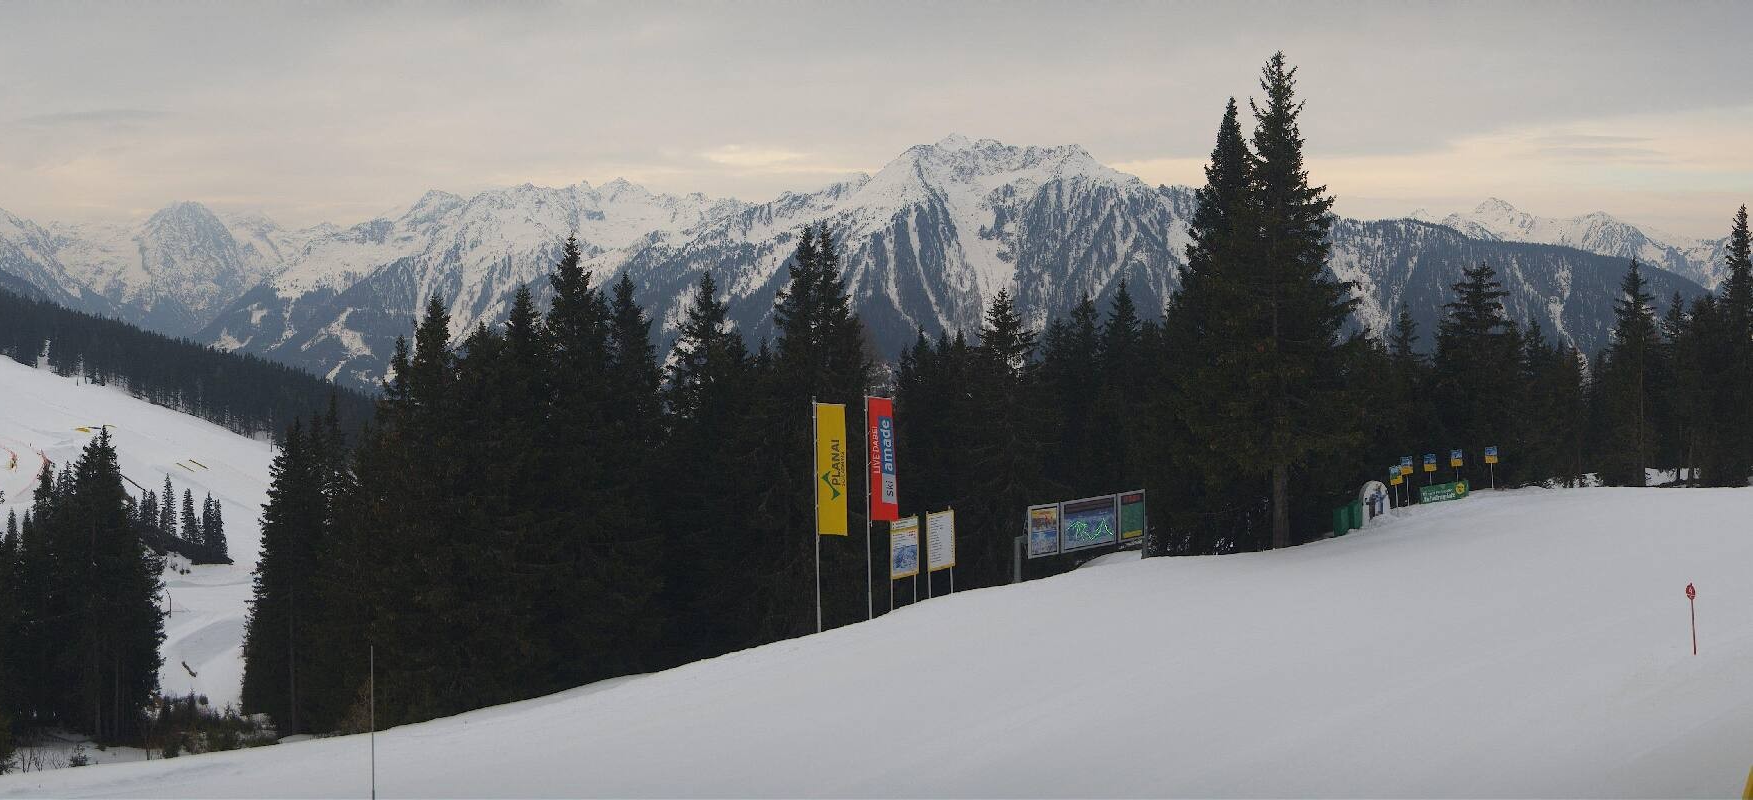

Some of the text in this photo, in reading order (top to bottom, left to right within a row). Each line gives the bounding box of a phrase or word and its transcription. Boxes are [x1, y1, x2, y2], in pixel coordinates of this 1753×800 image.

[831, 439, 841, 486] PLANAI
[871, 426, 881, 474] LIVE DABEI
[880, 419, 894, 497] ski amade
